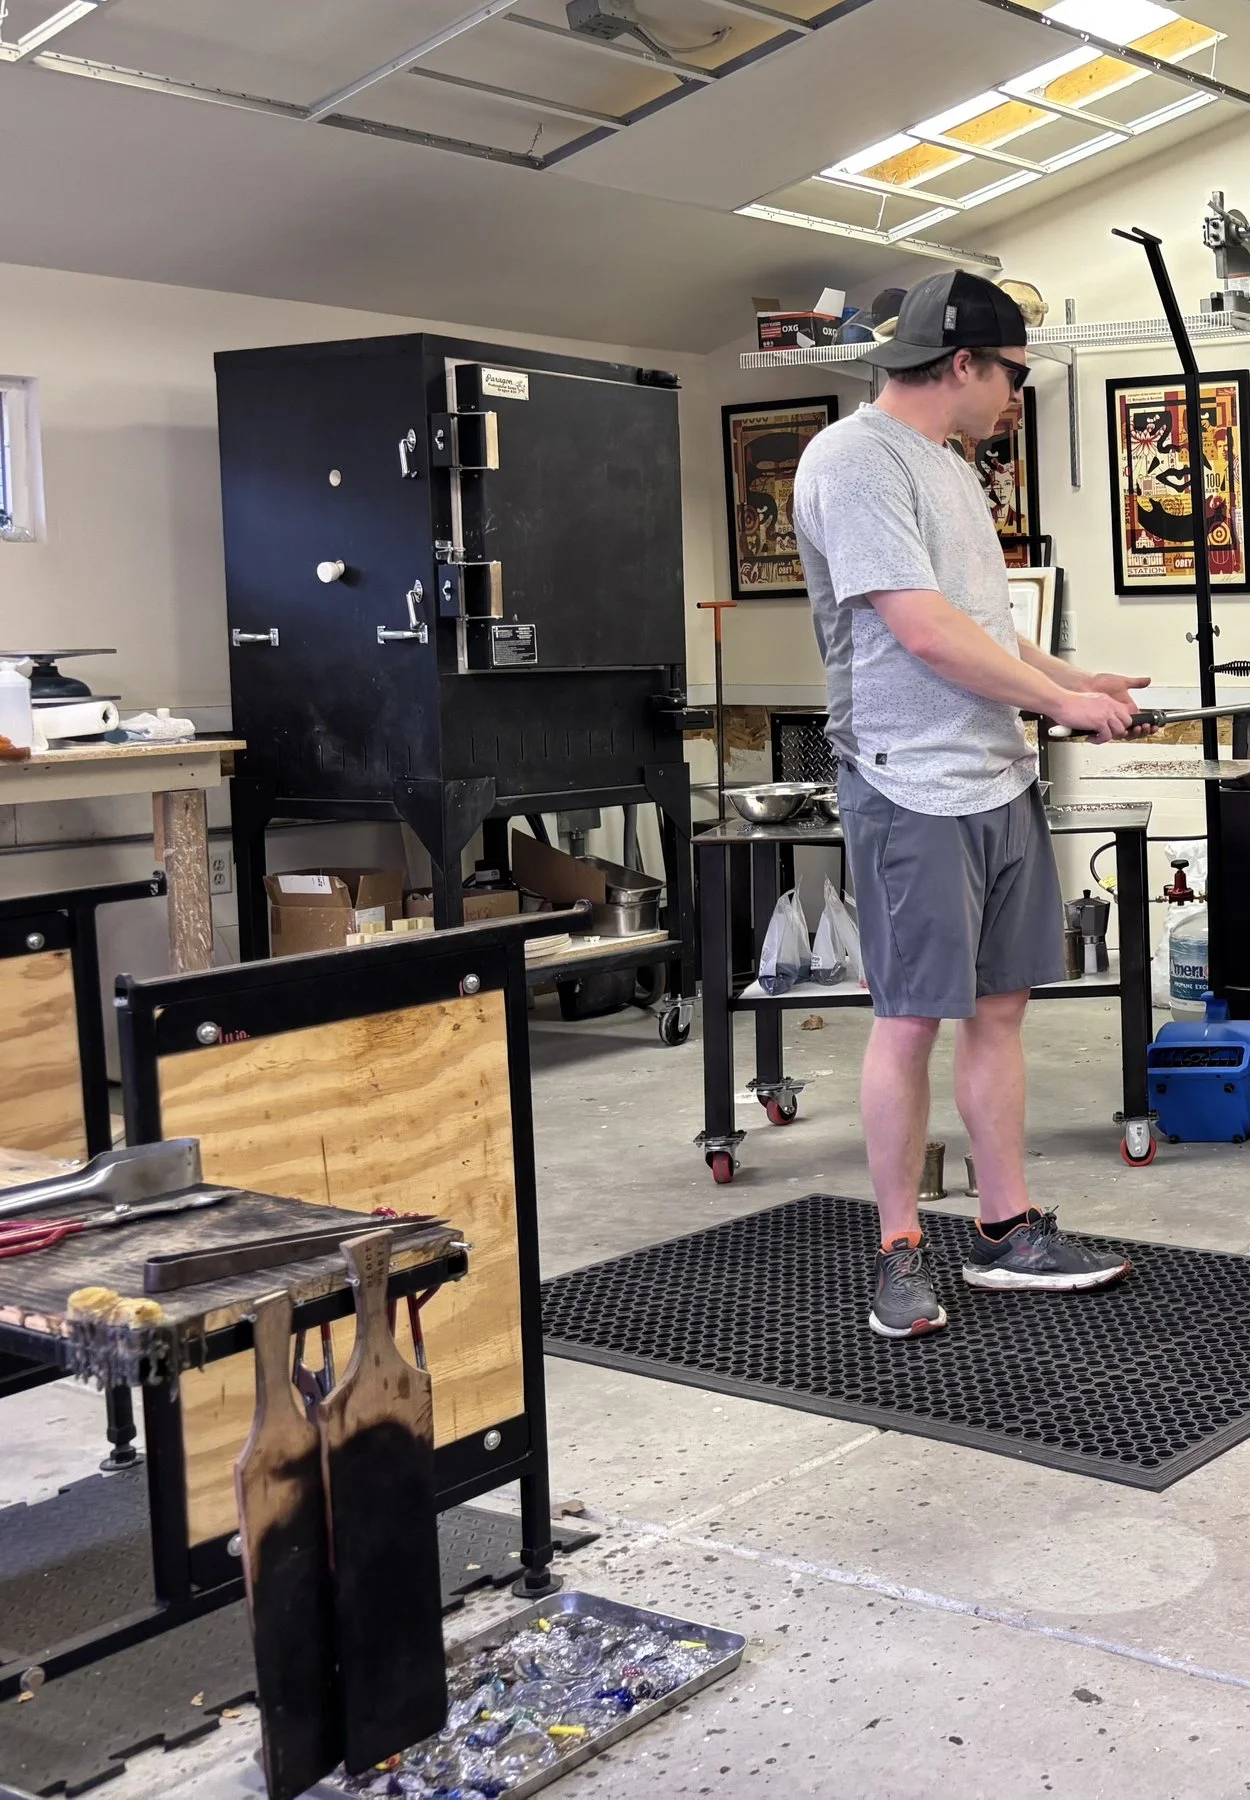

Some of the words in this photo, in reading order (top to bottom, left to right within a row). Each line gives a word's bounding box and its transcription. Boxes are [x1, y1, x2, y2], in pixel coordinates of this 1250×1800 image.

[782, 325, 799, 333] OXG
[485, 373, 513, 386] Paragon
[1205, 473, 1220, 489] 100
[1174, 558, 1193, 569] OBEY
[778, 565, 793, 575] OBEY
[1127, 566, 1165, 576] STATION
